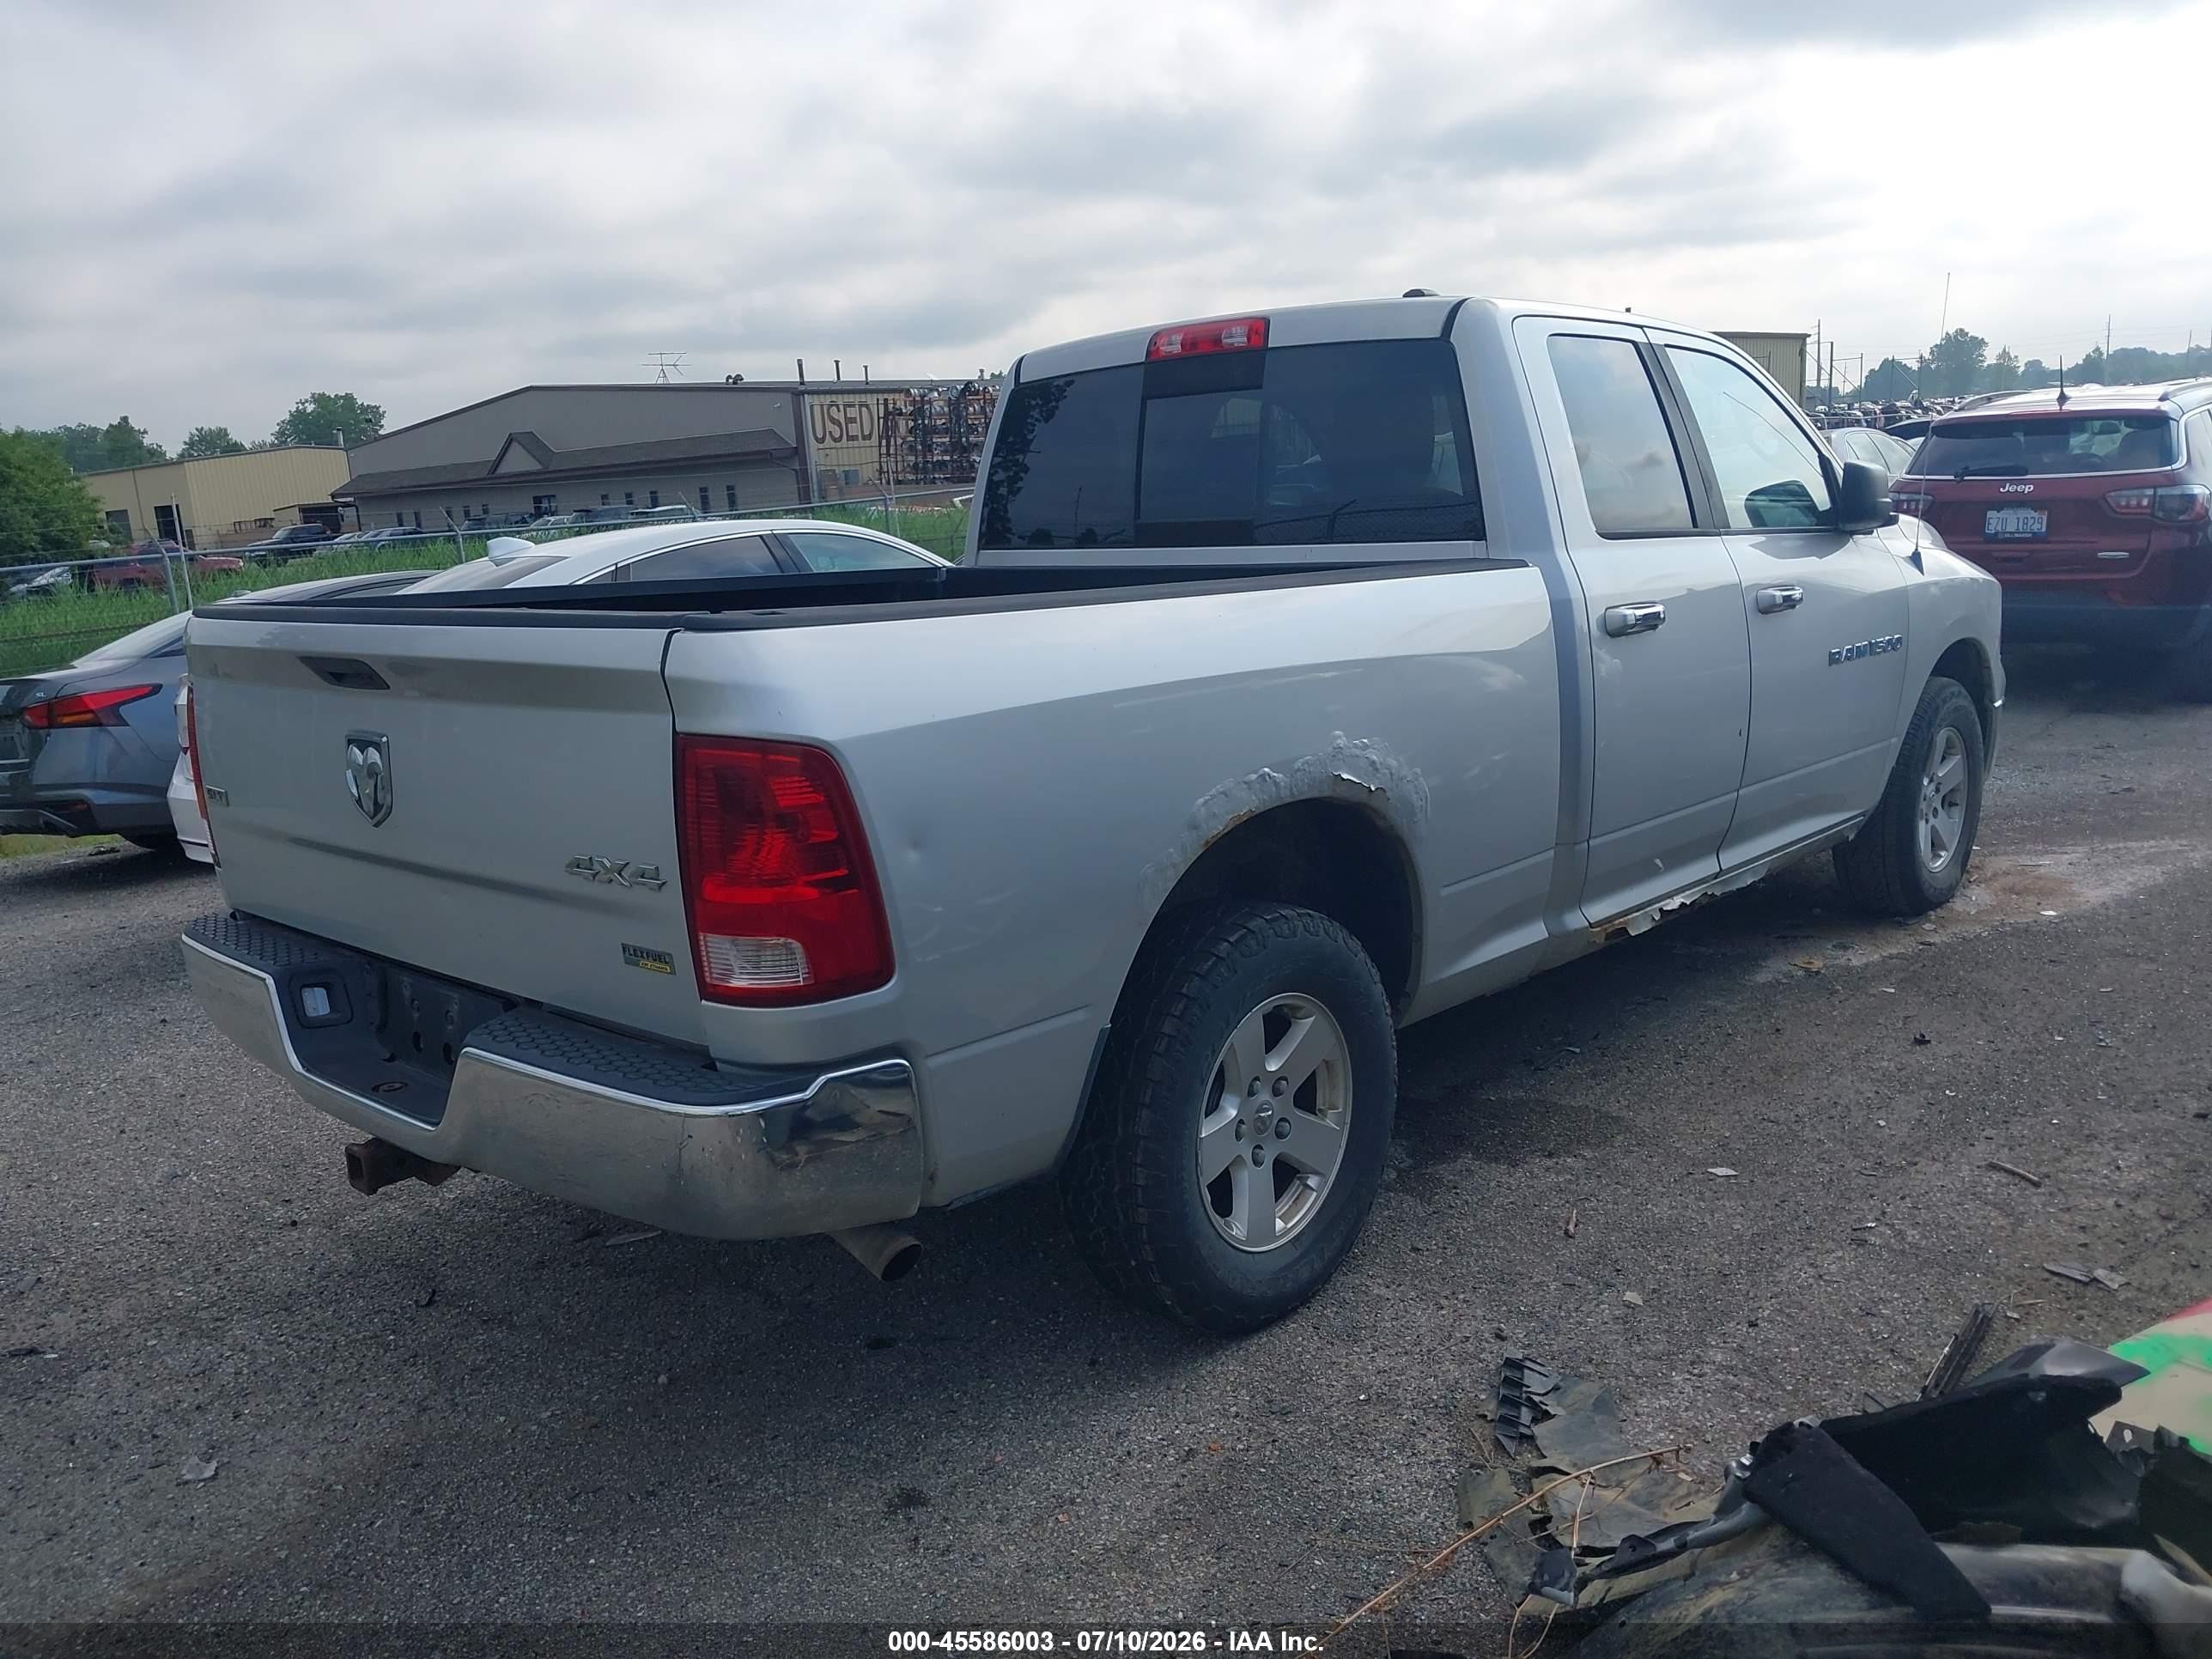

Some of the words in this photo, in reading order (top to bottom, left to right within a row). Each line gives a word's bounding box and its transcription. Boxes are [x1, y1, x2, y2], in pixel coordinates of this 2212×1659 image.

[810, 401, 874, 445] USED
[1999, 483, 2034, 494] Jeep
[1987, 517, 2008, 532] EZU
[2014, 516, 2043, 531] 1829
